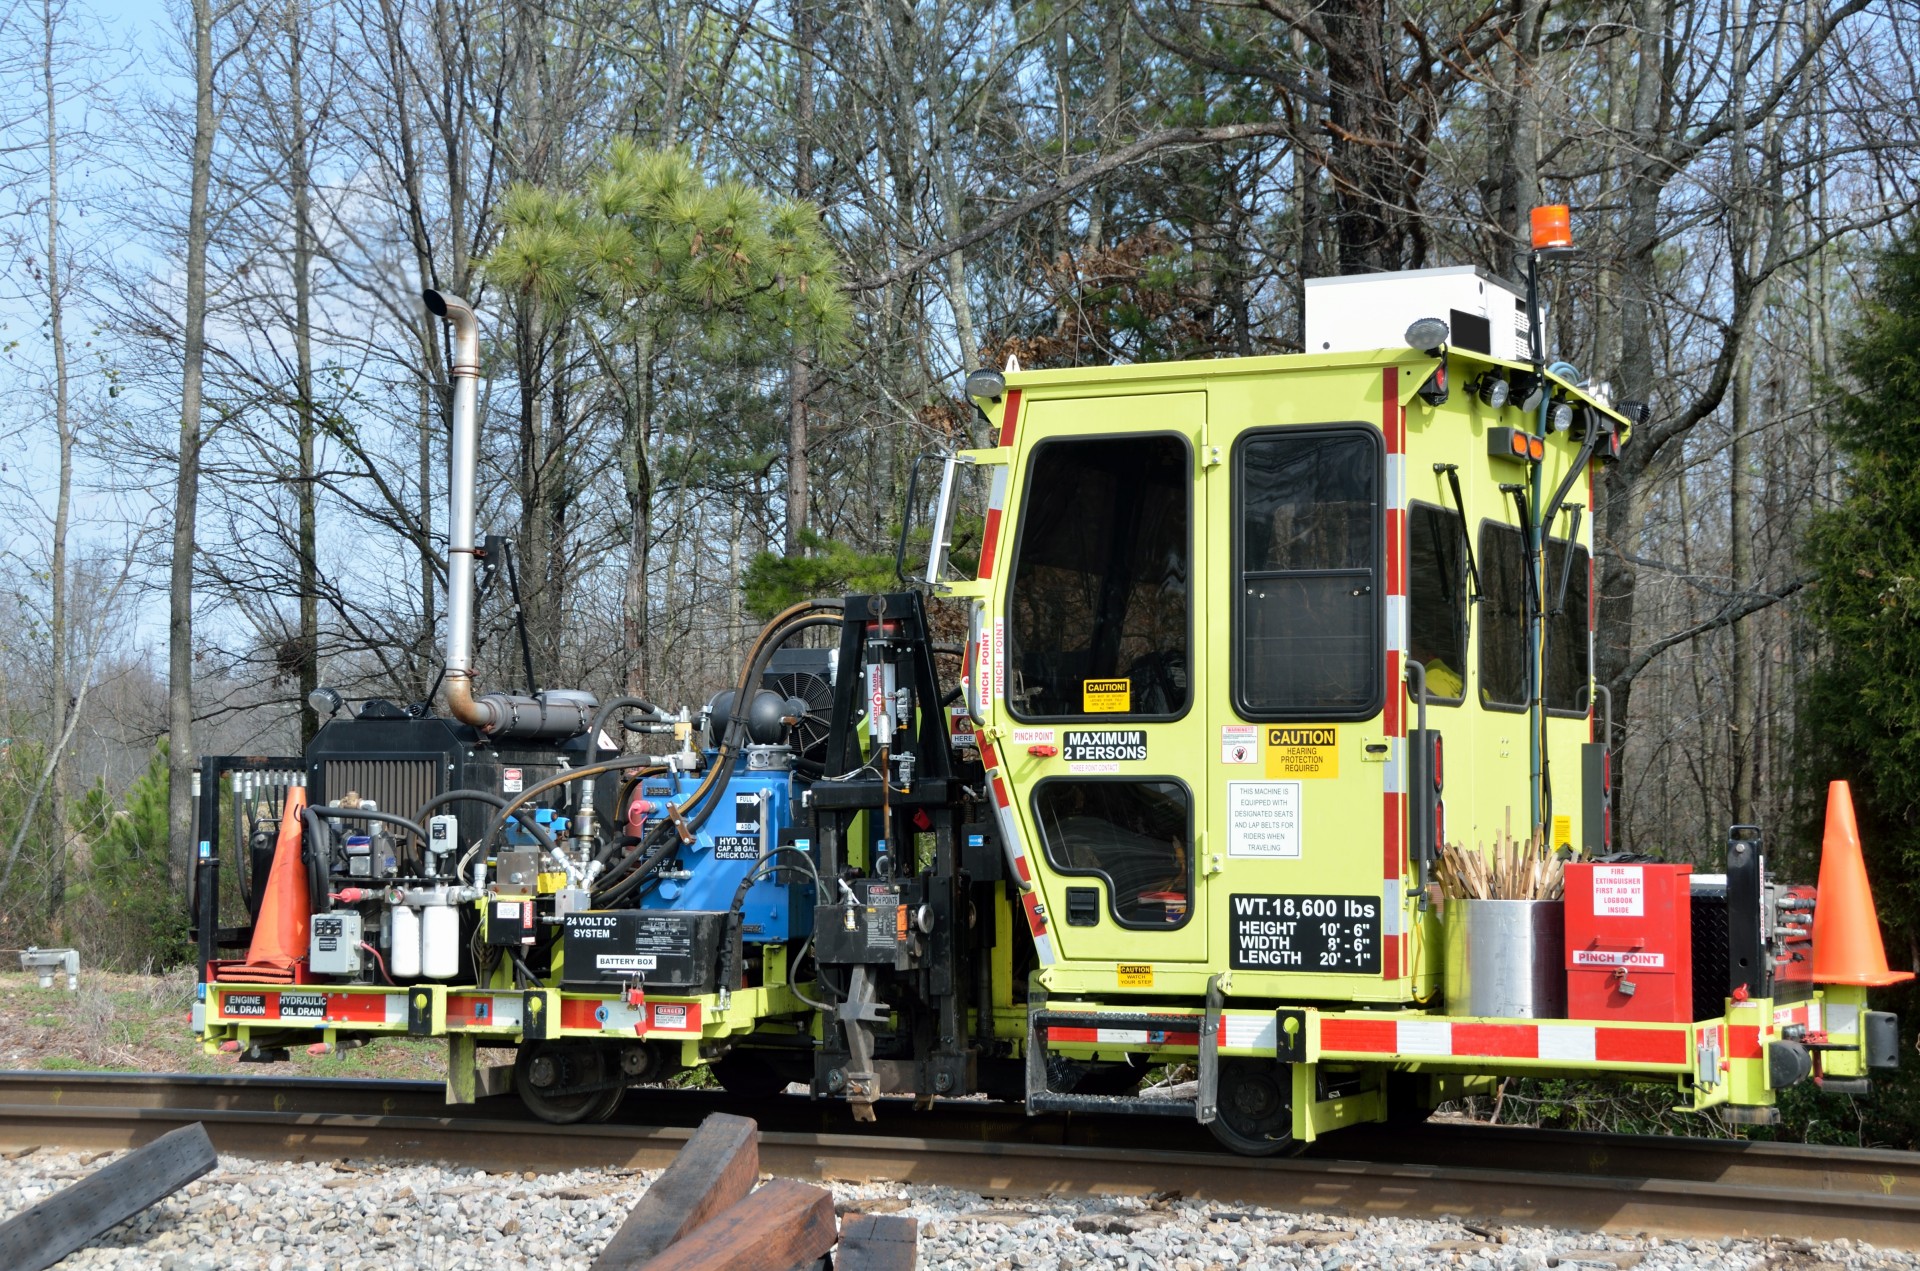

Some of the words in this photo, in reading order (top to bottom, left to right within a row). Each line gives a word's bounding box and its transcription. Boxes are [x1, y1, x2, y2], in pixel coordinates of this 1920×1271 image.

[996, 622, 1004, 654] POINT
[996, 661, 1004, 694] PINCH
[1088, 684, 1126, 692] CAUTION!
[1014, 732, 1032, 741] PINCH
[1034, 731, 1054, 740] POINT
[1069, 732, 1140, 746] MAXIMUM
[1270, 730, 1334, 745] CAUTION
[1064, 746, 1072, 760] 2
[1076, 746, 1147, 760] PERSONS
[1070, 764, 1084, 772] THREE
[1098, 764, 1118, 772] CONTACT
[720, 837, 740, 846] HYD.
[742, 838, 756, 846] OIL
[882, 896, 898, 904] POINTS
[1344, 900, 1375, 918] lbs
[566, 916, 578, 926] 24
[578, 917, 602, 926] VOLT
[604, 918, 617, 926] DC
[574, 929, 610, 938] SYSTEM
[1239, 920, 1297, 936] HEIGHT
[1320, 922, 1340, 936] 10'
[1353, 923, 1370, 938] 6"
[1240, 936, 1290, 950] WIDTH
[1327, 938, 1340, 951] 8'
[1353, 938, 1370, 952] 6"
[1239, 950, 1302, 964] LENGTH
[1320, 952, 1341, 966] 20'
[1354, 953, 1370, 966] 1"
[1578, 952, 1615, 962] PINCH
[1622, 954, 1658, 964] POINT
[230, 995, 261, 1004] ENGINE
[280, 996, 327, 1006] HYDRAULIC
[224, 1005, 238, 1014] OIL
[240, 1006, 266, 1014] DRAIN
[282, 1007, 296, 1016] OIL
[298, 1008, 324, 1016] DRAIN
